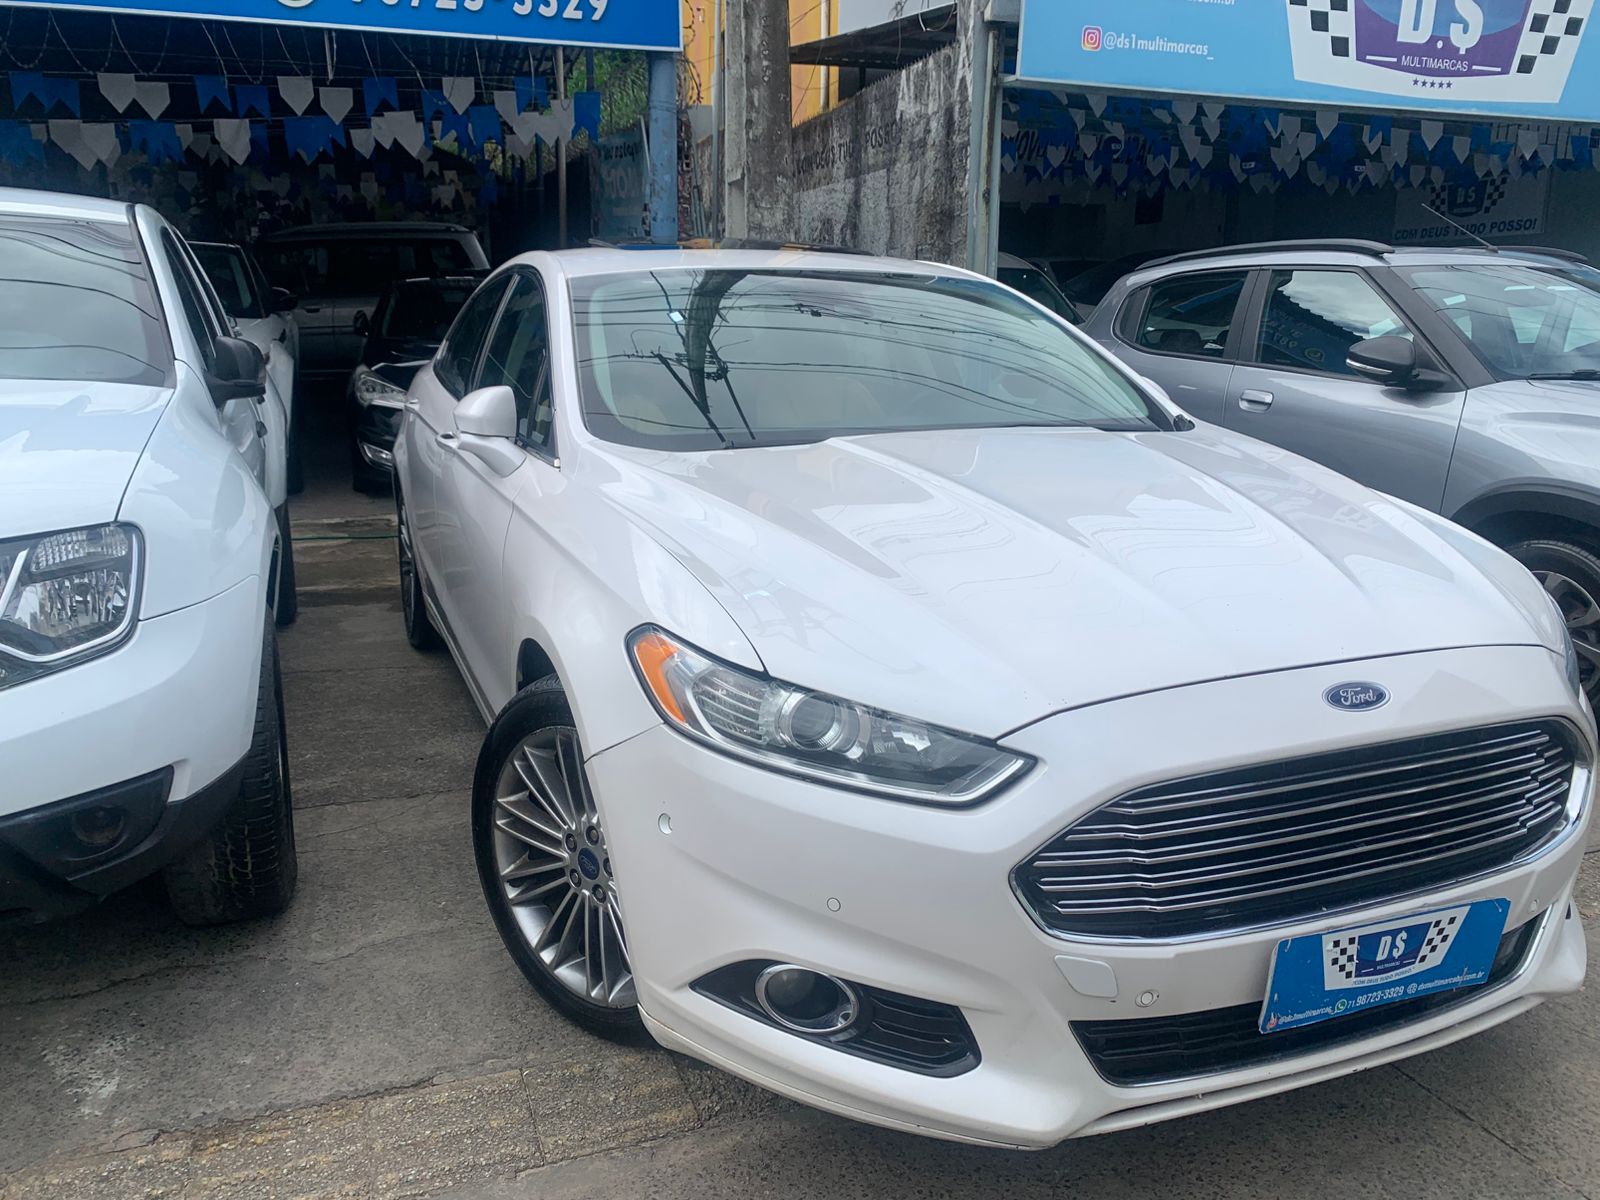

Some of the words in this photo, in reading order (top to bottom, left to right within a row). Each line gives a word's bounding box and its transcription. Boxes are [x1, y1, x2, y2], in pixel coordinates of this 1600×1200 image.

[1401, 55, 1469, 71] MULTIMARCAS
[1394, 229, 1419, 240] COM
[1420, 226, 1450, 238] DEUS
[1489, 218, 1537, 234] POSSO!
[1339, 687, 1377, 705] Ford
